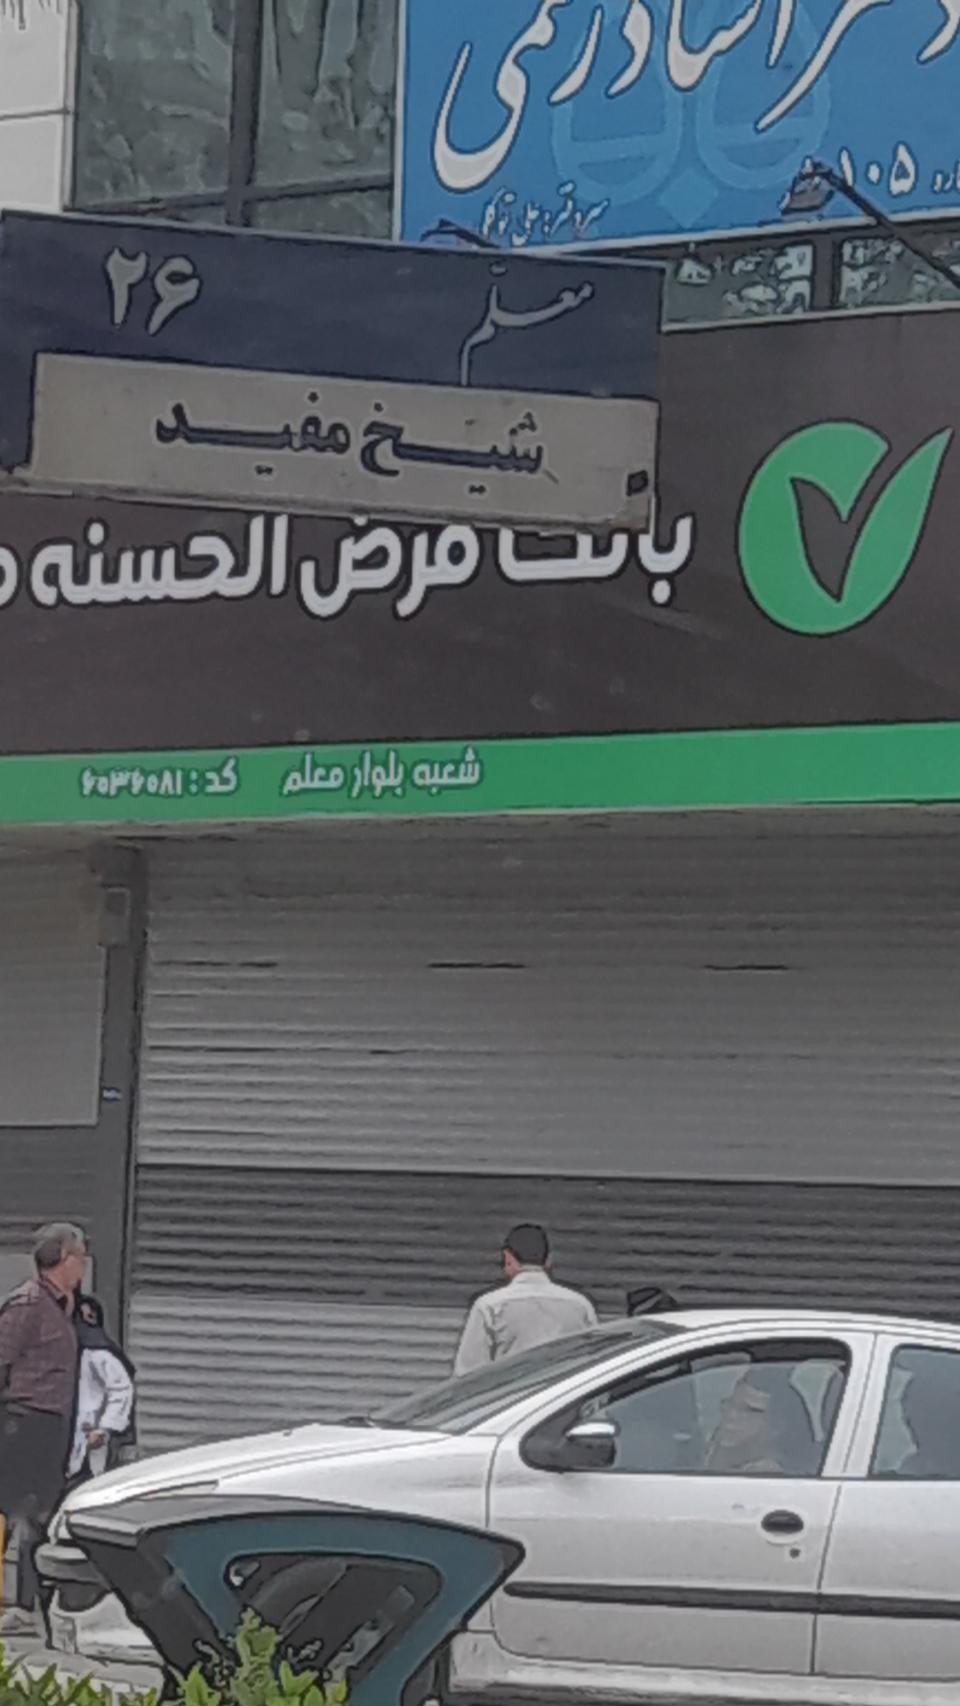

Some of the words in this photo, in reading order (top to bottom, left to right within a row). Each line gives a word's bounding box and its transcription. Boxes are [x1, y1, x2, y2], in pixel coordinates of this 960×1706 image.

[103, 246, 202, 336] ۲۶
[154, 392, 352, 476] مفید
[359, 400, 546, 496] شیخ
[29, 514, 290, 609] الحسنه
[282, 752, 344, 796] معلم
[351, 750, 405, 799] بلوار
[411, 746, 481, 796] شعبه
